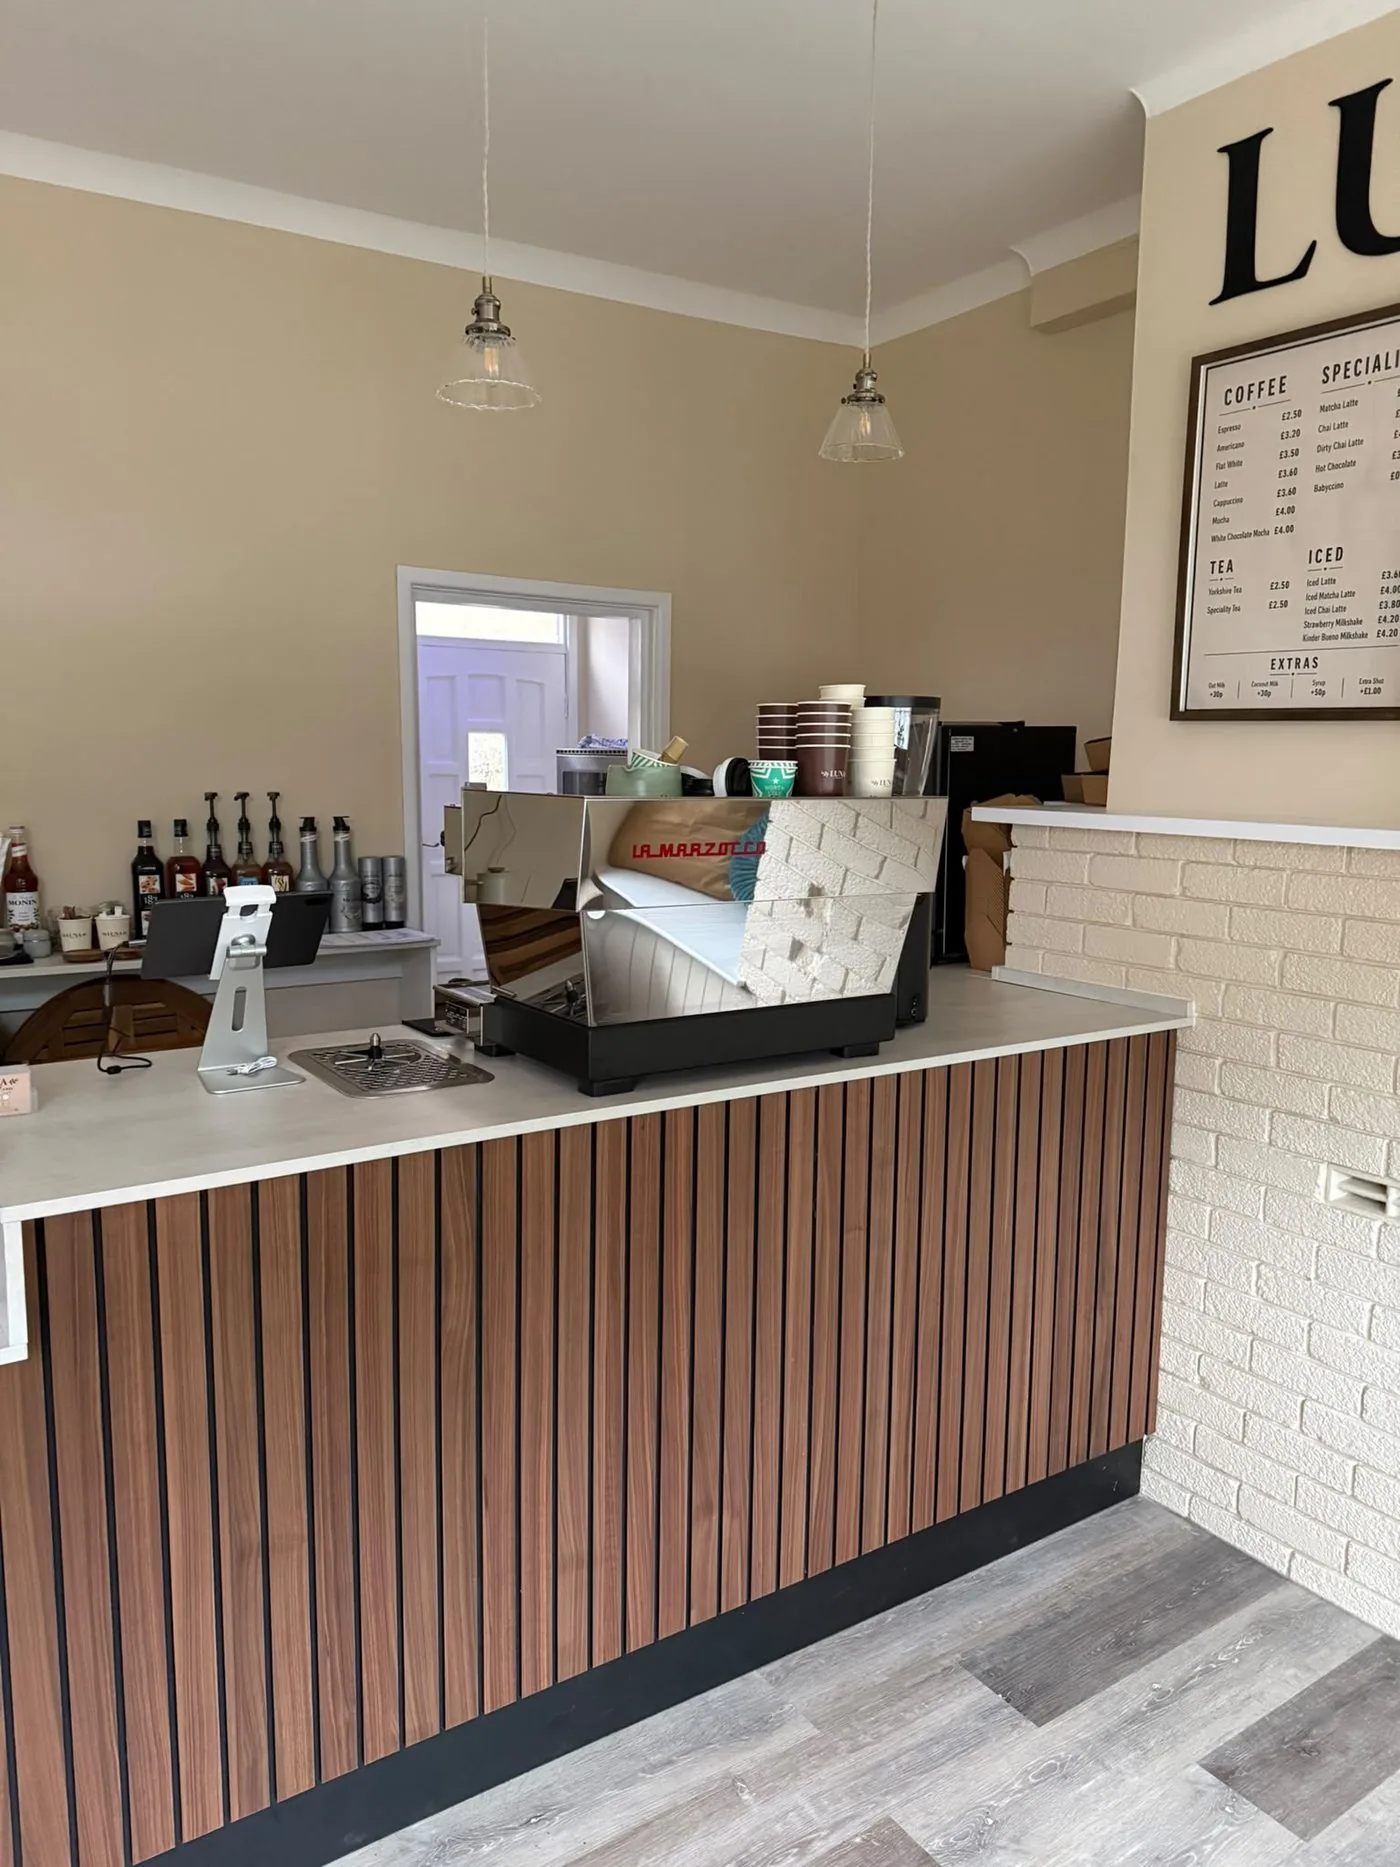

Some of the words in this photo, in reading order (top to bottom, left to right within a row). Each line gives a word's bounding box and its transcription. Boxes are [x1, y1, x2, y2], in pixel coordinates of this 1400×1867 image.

[1224, 375, 1288, 406] COFFEE
[1319, 401, 1341, 413] Matcha
[1342, 399, 1359, 409] Latte
[1281, 409, 1302, 421] £2.50
[1217, 423, 1241, 435] Espresso
[1317, 423, 1331, 433] Chai
[1333, 421, 1349, 431] Latte
[1280, 429, 1300, 440] £3.20
[1216, 440, 1245, 452] Americano
[1316, 443, 1332, 453] Dirty
[1333, 440, 1347, 450] Chai
[1348, 438, 1364, 448] Latte
[1279, 448, 1299, 460] £3.50
[1215, 460, 1226, 470] Flat
[1227, 459, 1243, 470] White
[1315, 463, 1326, 472] Hot
[1327, 459, 1357, 471] Chocolate
[1278, 467, 1298, 479] £3.60
[1214, 480, 1228, 489] Latte
[1314, 481, 1344, 493] Babyccino
[1277, 487, 1297, 498] £3.60
[1213, 496, 1244, 508] Cappuccino
[1276, 505, 1296, 516] £4.00
[1212, 516, 1230, 525] Mocha
[1211, 534, 1226, 543] White
[1227, 530, 1252, 541] Chocolate
[1253, 528, 1270, 538] Mocha
[1274, 524, 1294, 536] £4.00
[1308, 546, 1344, 564] ICED
[1210, 559, 1234, 575] TEA
[1270, 580, 1290, 591] £2.50
[1306, 578, 1319, 587] Iced
[1320, 577, 1336, 586] Latte
[1208, 586, 1232, 596] Yorkshire
[1233, 586, 1242, 594] Tea
[1306, 592, 1318, 601] Iced
[1318, 591, 1340, 600] Matcha
[1340, 590, 1356, 598] Latte
[1207, 606, 1231, 616] Speciality
[1232, 604, 1241, 613] Tea
[1268, 600, 1288, 610] £2.50
[1304, 606, 1316, 616] Iced
[1318, 605, 1331, 614] Chai
[1332, 604, 1347, 613] Latte
[1304, 620, 1335, 630] Strawberry
[1335, 617, 1363, 627] Milkshake
[1378, 614, 1400, 625] £4.20
[1302, 633, 1320, 642] Kinder
[1340, 630, 1368, 640] Milkshake
[1376, 628, 1398, 639] £4.20
[1270, 656, 1319, 670] EXTRAS
